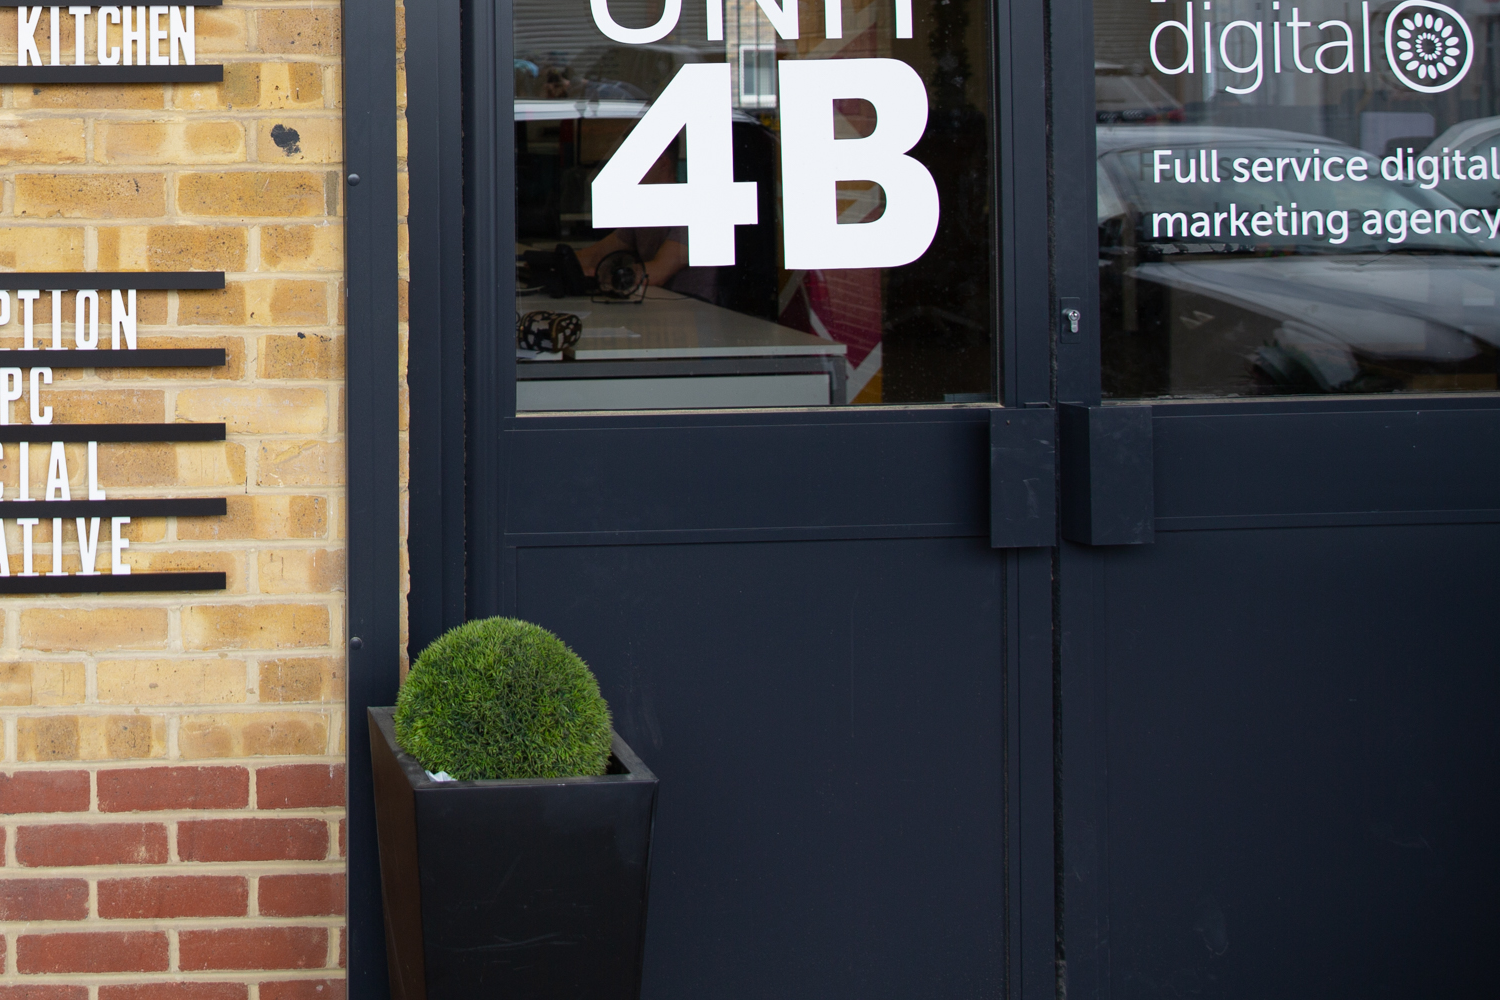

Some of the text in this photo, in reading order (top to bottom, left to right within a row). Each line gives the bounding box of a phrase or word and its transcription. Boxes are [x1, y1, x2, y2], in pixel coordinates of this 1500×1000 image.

[17, 4, 196, 67] KITCHEN
[1149, 1, 1372, 95] digital
[591, 57, 940, 270] 4B
[1152, 147, 1500, 189] Full service digital
[1151, 203, 1500, 244] marketing agency
